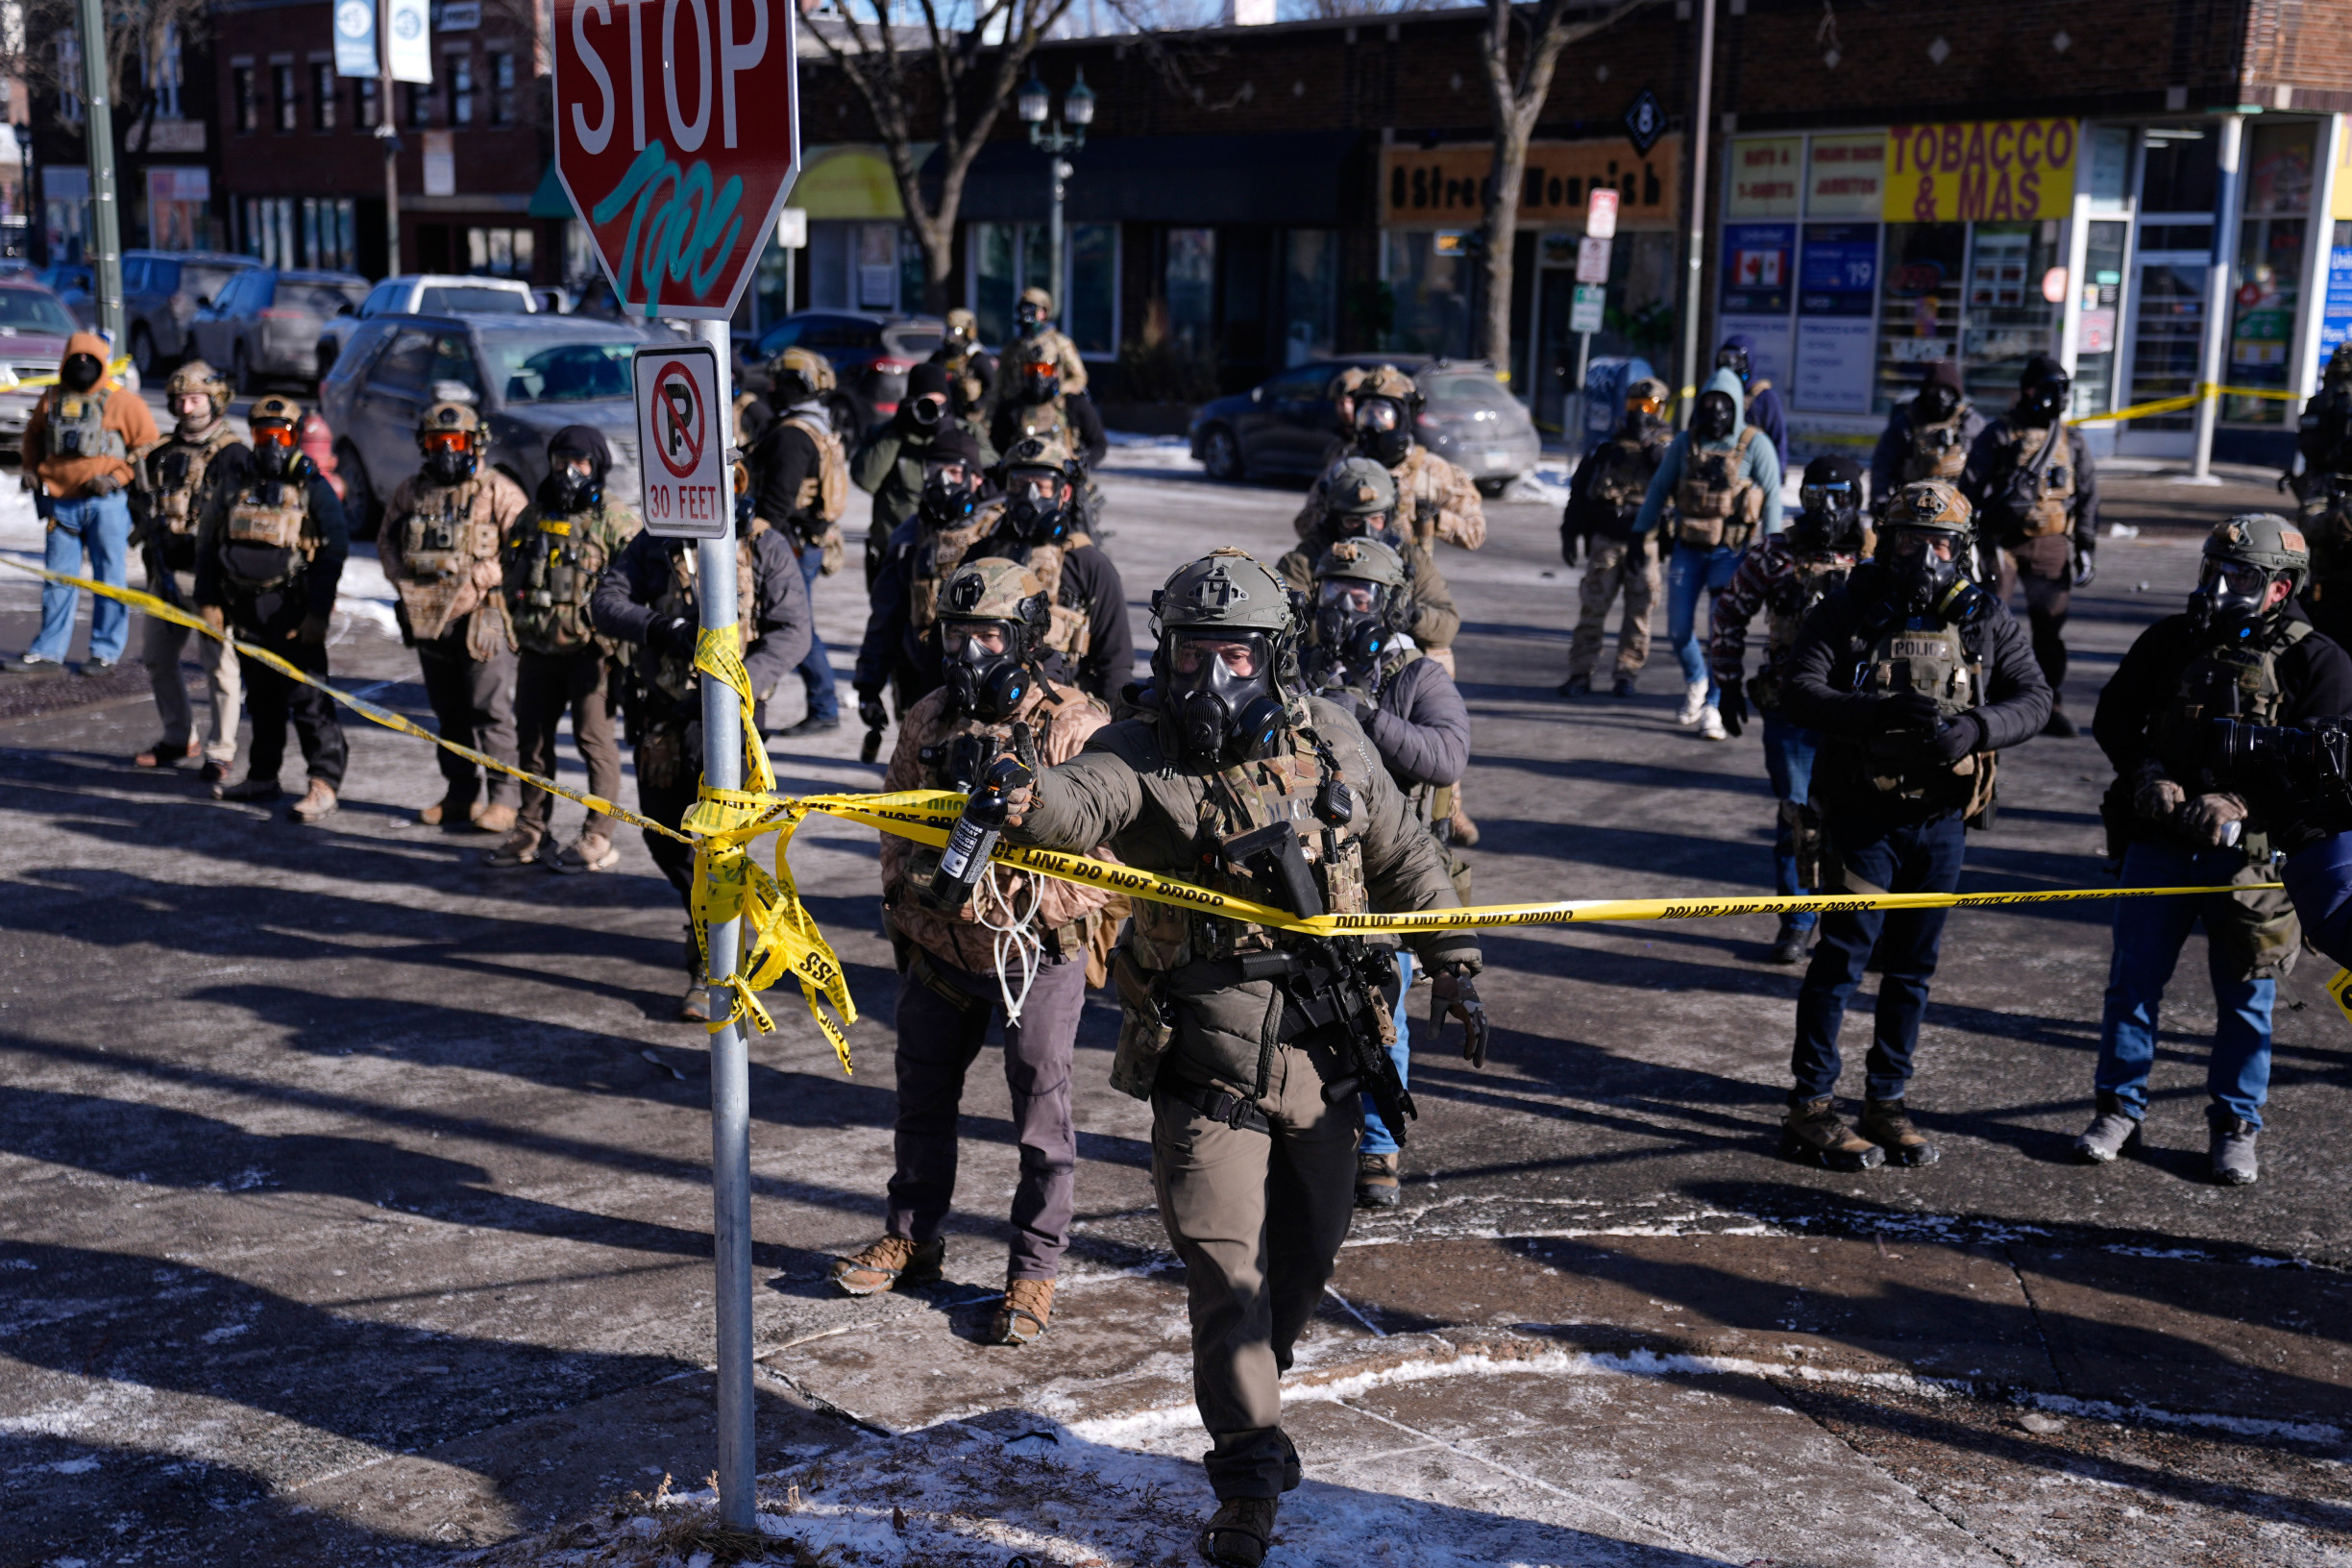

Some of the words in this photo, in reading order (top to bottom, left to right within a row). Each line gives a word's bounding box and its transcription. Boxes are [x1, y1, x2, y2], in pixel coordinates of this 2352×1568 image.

[571, 0, 770, 155] STOP
[1890, 118, 2073, 175] TOBACCO
[1412, 166, 1497, 208] Stre
[1912, 176, 1938, 222] &
[1957, 171, 2042, 221] MAS
[650, 484, 671, 519] 30
[678, 485, 717, 521] FEET
[1895, 641, 1948, 657] POLICE
[1264, 796, 1315, 824] OLICE
[1021, 848, 1067, 873] LINE
[1072, 862, 1103, 880] DO
[1107, 870, 1153, 891] NOT
